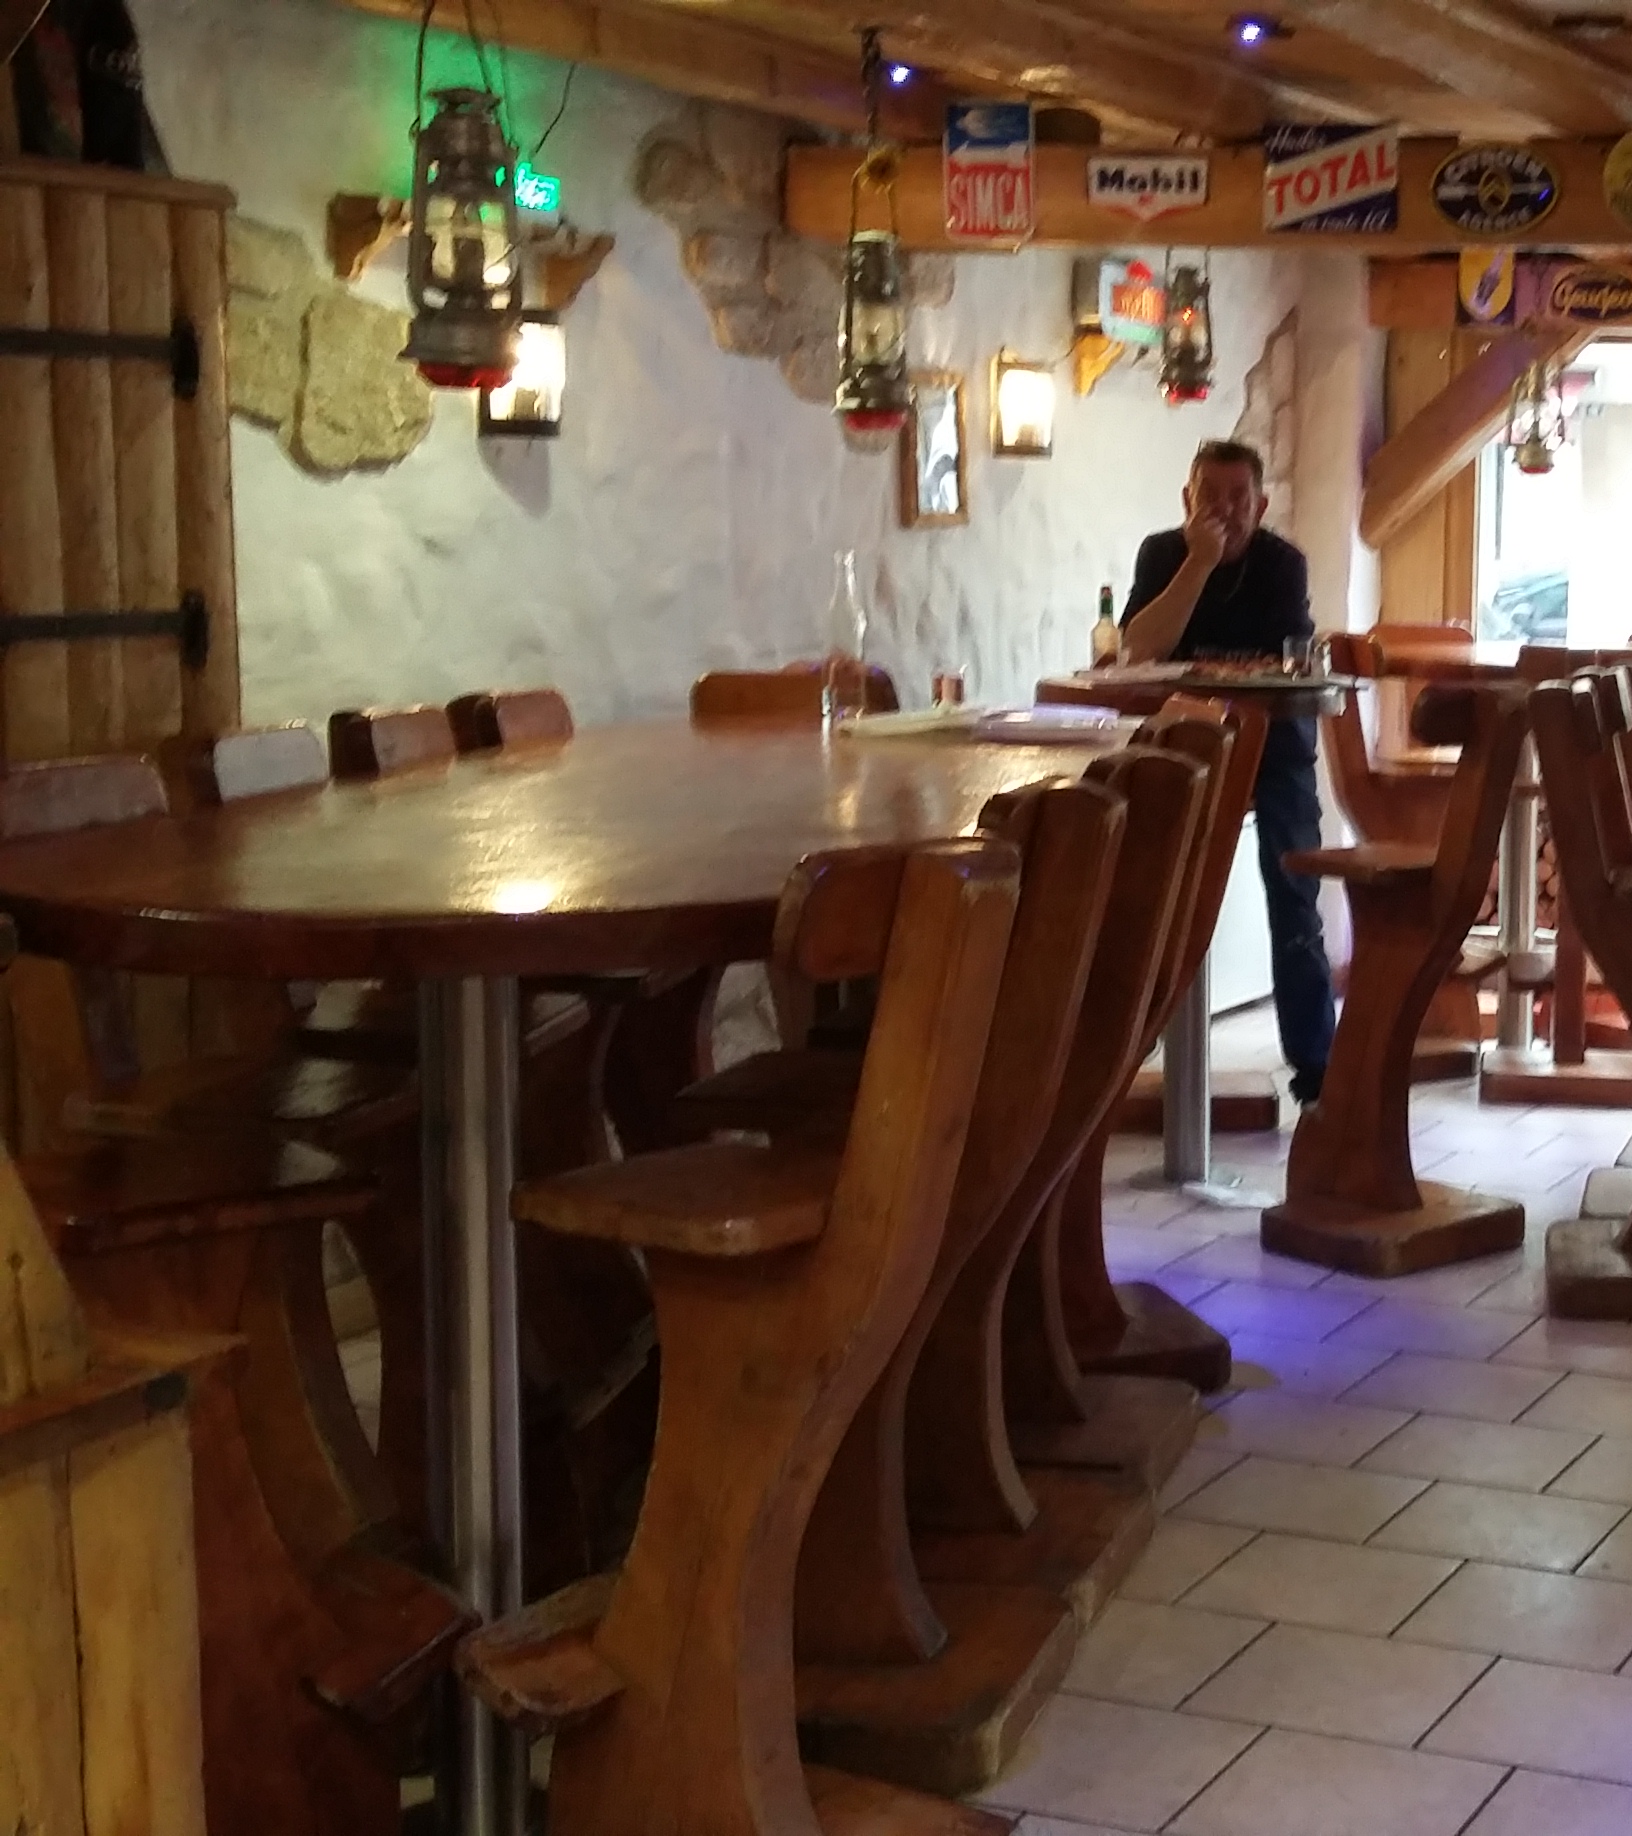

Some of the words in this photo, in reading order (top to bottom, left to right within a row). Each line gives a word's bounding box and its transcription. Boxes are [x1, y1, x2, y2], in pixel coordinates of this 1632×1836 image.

[949, 171, 1030, 232] SIMCA
[1096, 166, 1199, 194] Mobil
[1265, 141, 1396, 217] TOTAL
